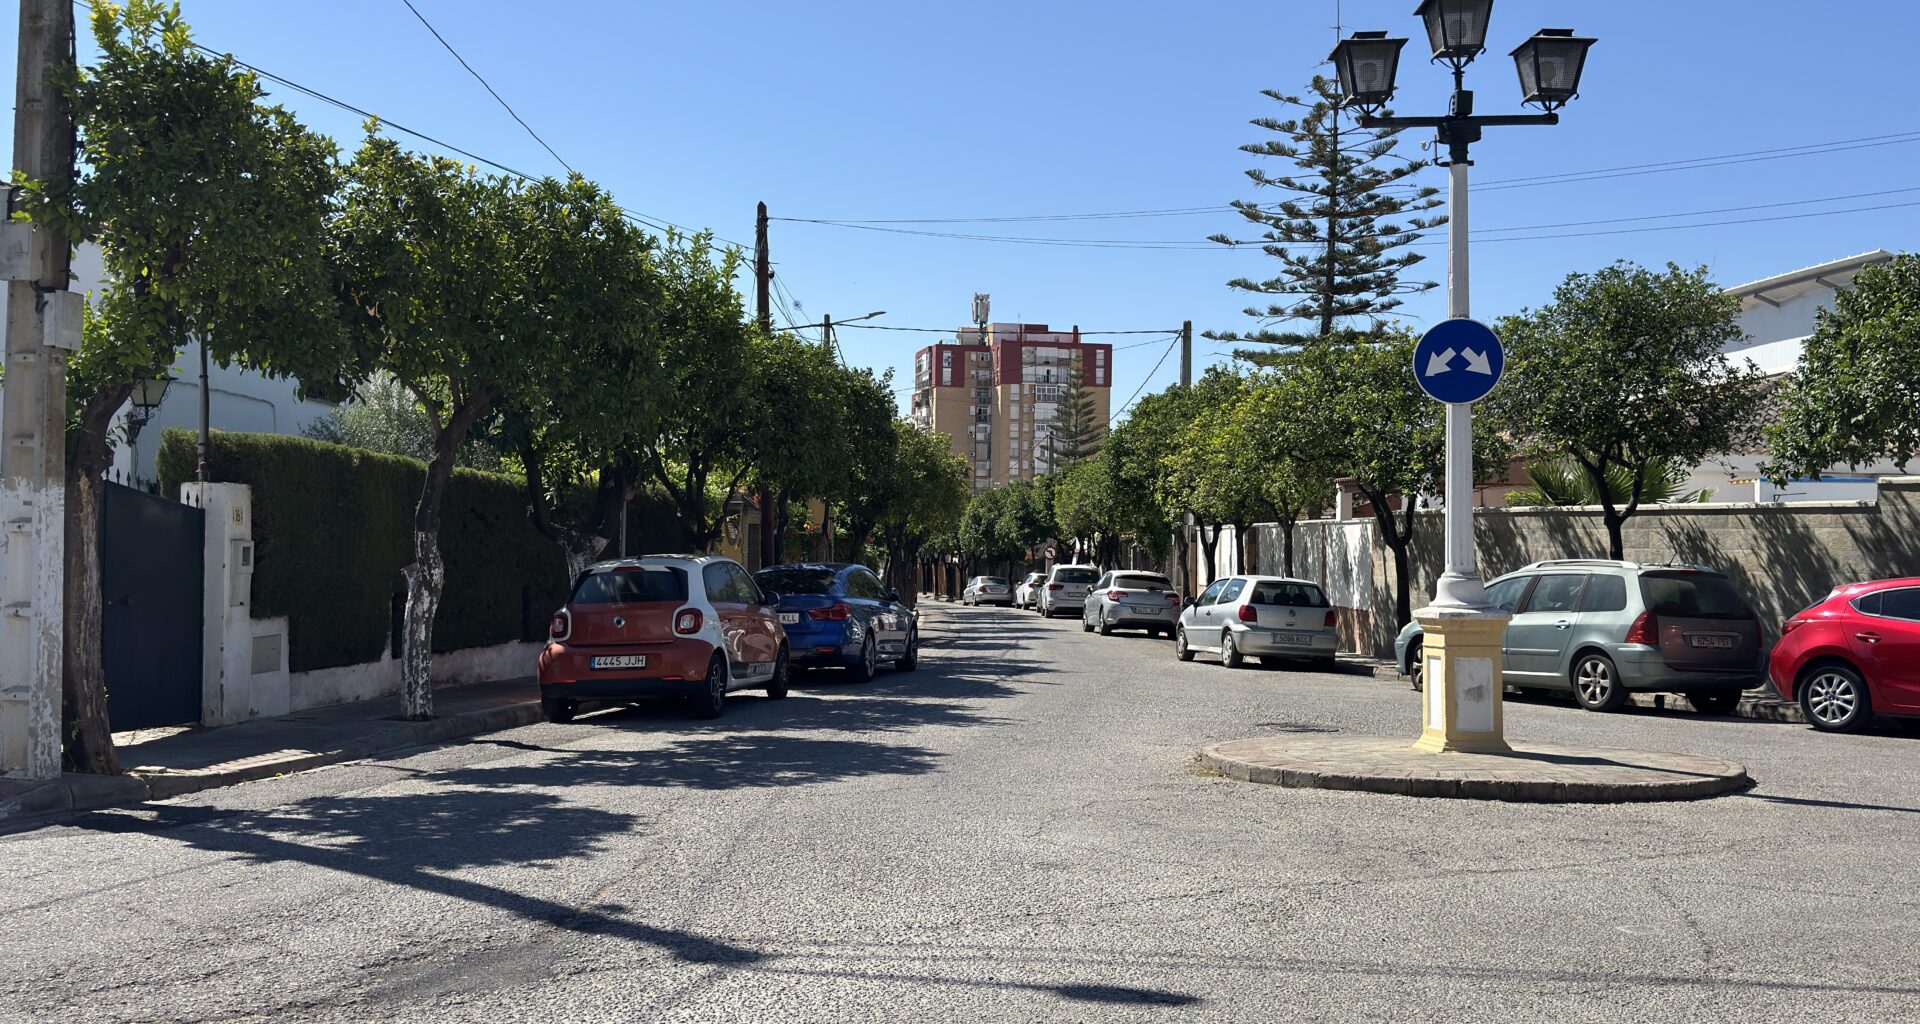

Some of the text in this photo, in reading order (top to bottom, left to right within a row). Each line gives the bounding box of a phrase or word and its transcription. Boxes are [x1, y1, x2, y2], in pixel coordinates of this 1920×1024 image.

[782, 614, 797, 622] KLL
[596, 656, 644, 667] 4445 JJH
